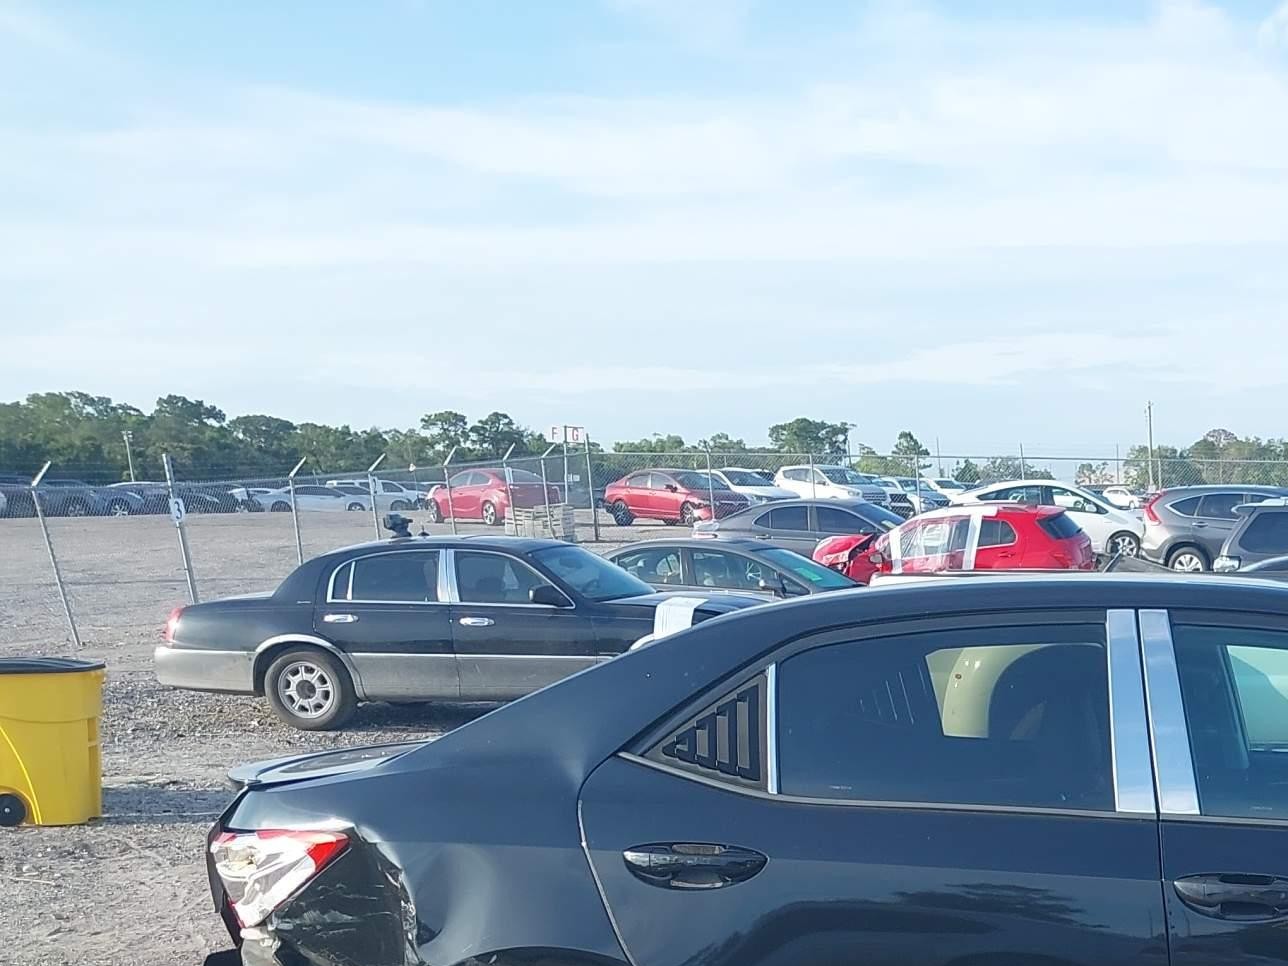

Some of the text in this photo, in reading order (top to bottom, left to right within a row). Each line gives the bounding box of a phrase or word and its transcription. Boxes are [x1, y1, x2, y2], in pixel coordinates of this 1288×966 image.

[551, 426, 558, 441] F
[571, 427, 579, 441] G
[174, 500, 183, 520] 3
